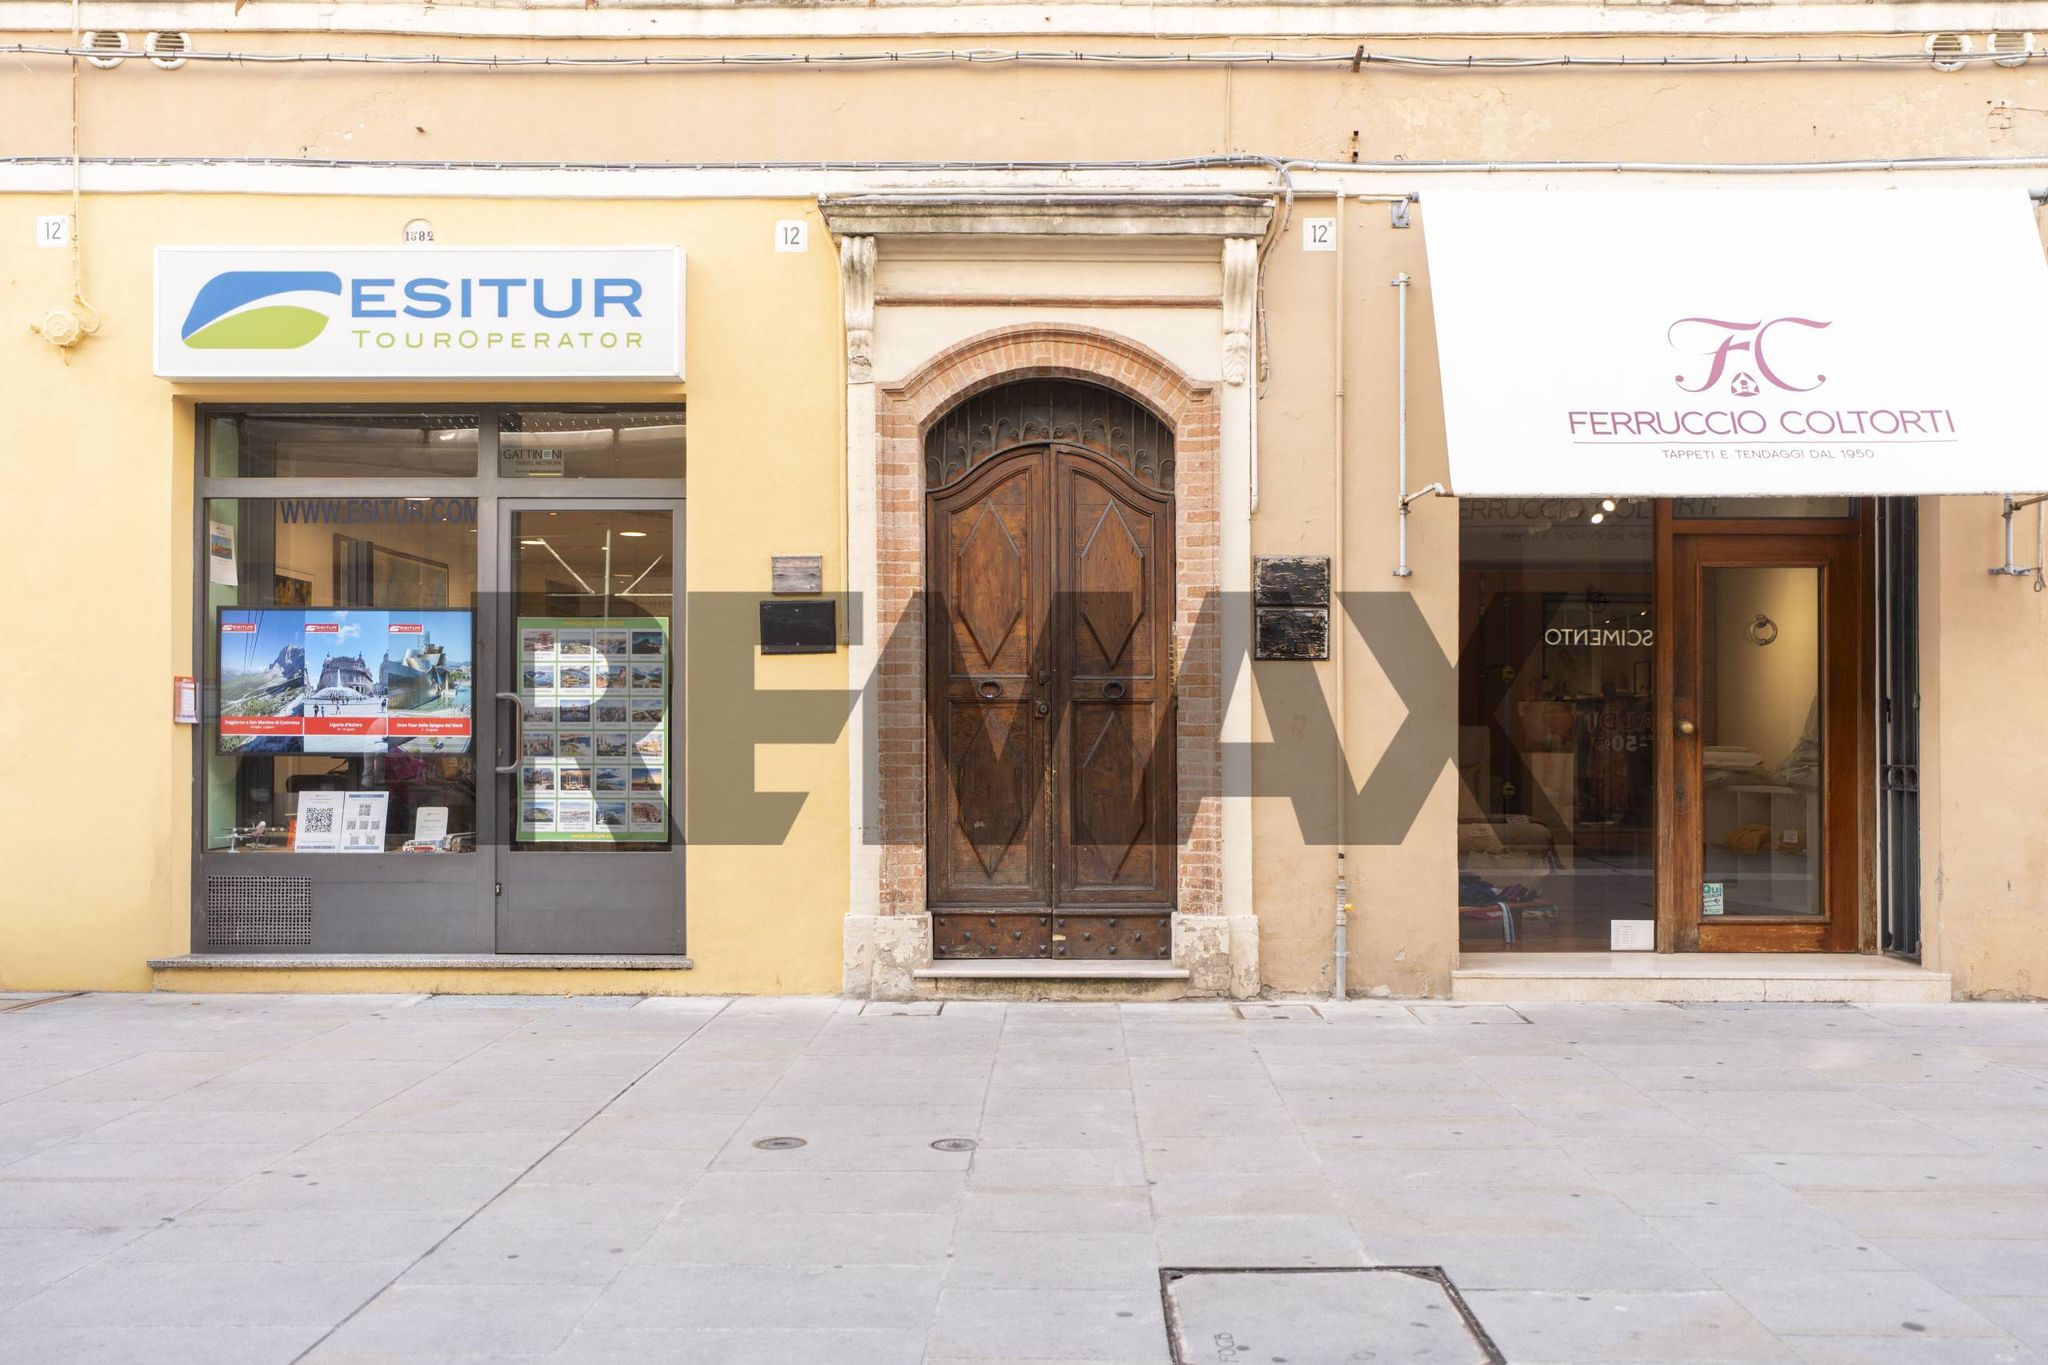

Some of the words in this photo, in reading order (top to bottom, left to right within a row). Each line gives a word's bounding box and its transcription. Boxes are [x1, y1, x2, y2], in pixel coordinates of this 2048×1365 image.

[405, 231, 435, 242] 1582
[782, 226, 800, 245] 12
[351, 277, 643, 319] ESITUR
[1567, 409, 1767, 436] FERRUCCIO
[1779, 408, 1956, 435] COLTORTI
[1661, 449, 1715, 459] TAPPETI
[1720, 449, 1730, 459] E
[1734, 449, 1805, 460] TENDAGGI
[1809, 449, 1836, 459] DAL
[1840, 448, 1875, 459] 1950
[280, 499, 478, 524] WWW.ESITUR.COM
[1703, 884, 1722, 894] Qui
